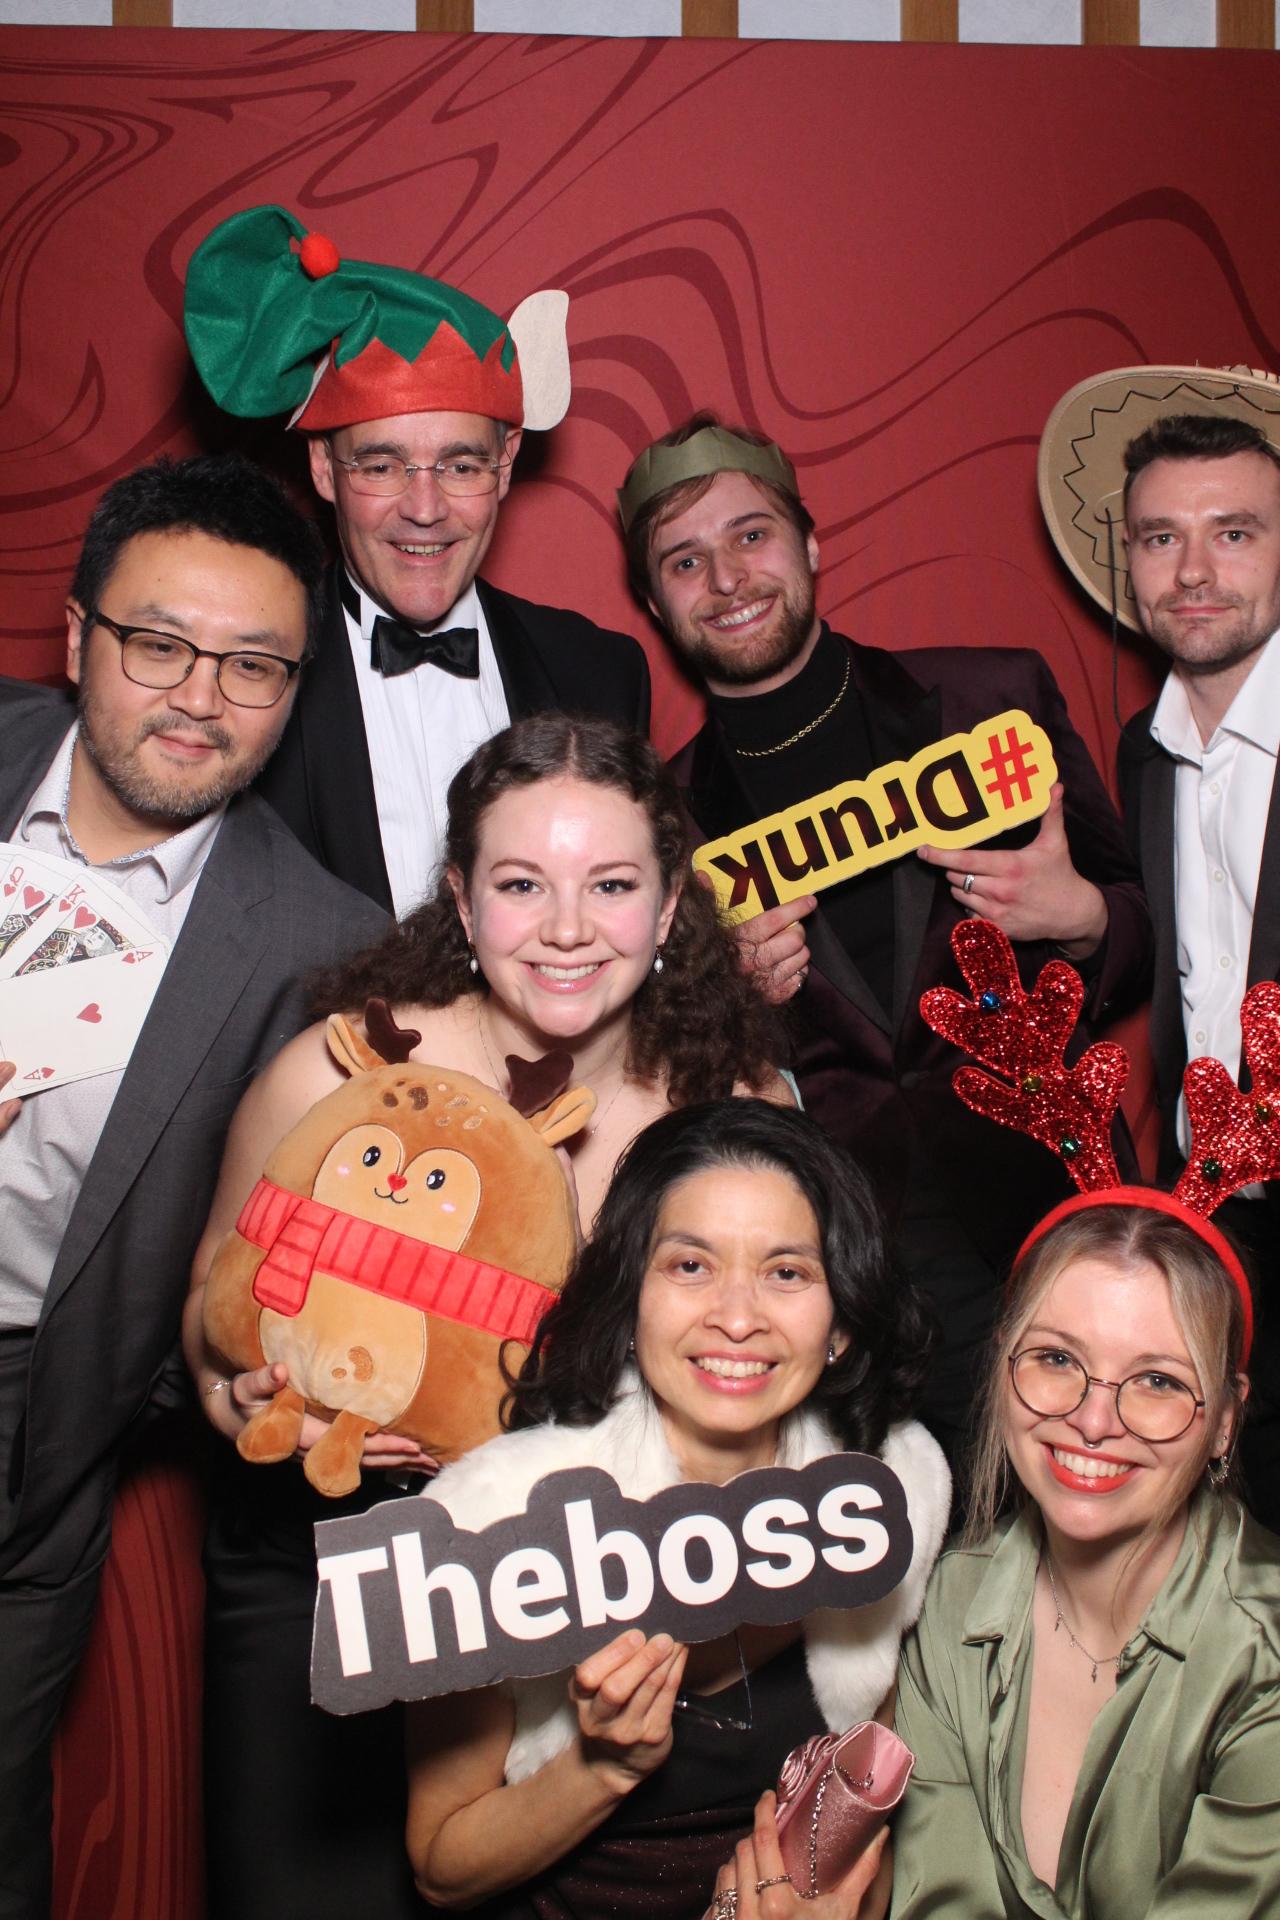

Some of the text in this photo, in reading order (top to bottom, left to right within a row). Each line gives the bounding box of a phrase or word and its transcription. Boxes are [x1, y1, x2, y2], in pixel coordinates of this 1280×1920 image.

[10, 866, 24, 886] Q
[66, 884, 85, 904] K
[137, 951, 154, 962] A
[24, 1070, 41, 1080] A
